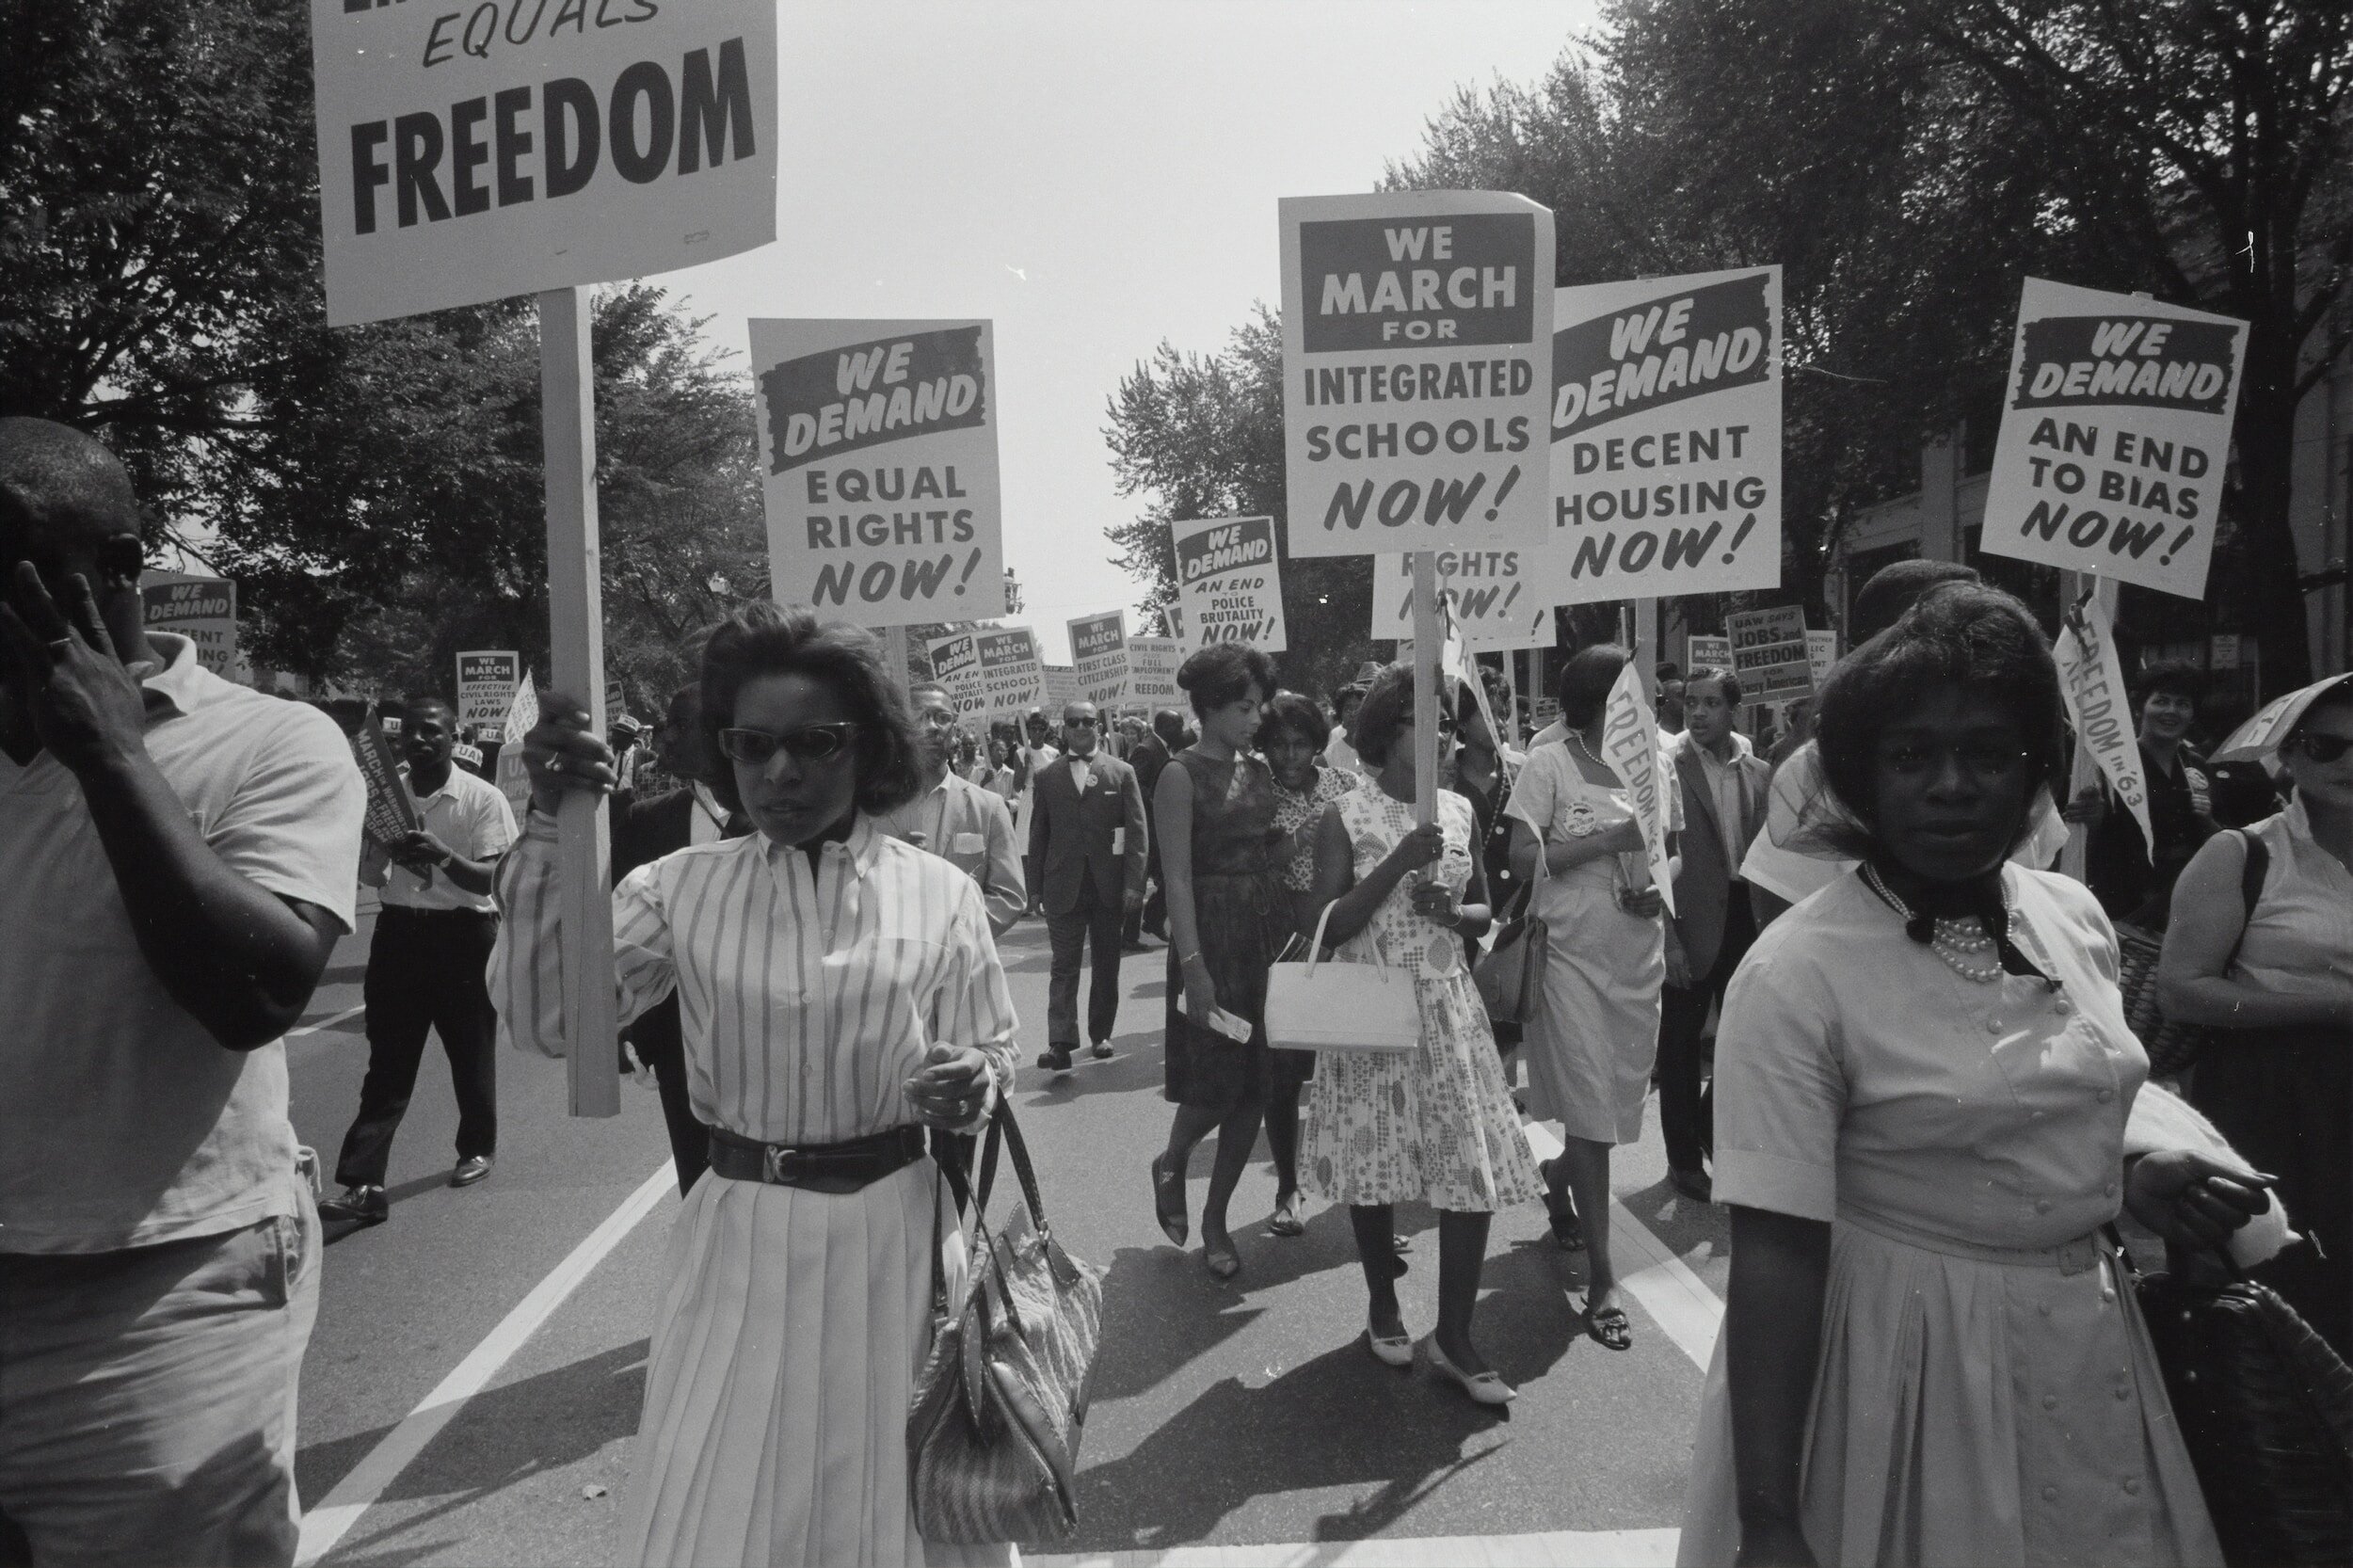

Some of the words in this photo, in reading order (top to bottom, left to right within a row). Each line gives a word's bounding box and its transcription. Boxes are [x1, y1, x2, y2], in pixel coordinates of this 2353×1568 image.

[351, 36, 755, 234] FREEDOM
[1385, 226, 1452, 262] WE
[1321, 265, 1515, 314] MARCH
[1383, 319, 1458, 341] FOR
[1609, 297, 1693, 361] WE
[2091, 321, 2171, 358] WE
[837, 343, 913, 395] WE
[1553, 327, 1762, 429] DEMAND
[2029, 360, 2224, 400] DEMAND
[1305, 359, 1532, 406] INTEGRATED
[784, 375, 977, 456] DEMAND
[1306, 416, 1529, 461] SCHOOLS
[1573, 424, 1749, 475] DECENT
[2028, 417, 2098, 456] AN
[2114, 430, 2209, 479] END
[807, 466, 967, 504] EQUAL
[1324, 464, 1521, 531] NOW!
[2028, 456, 2086, 494] TO
[2099, 470, 2199, 520] BIAS
[1556, 476, 1767, 527] HOUSING
[807, 509, 974, 549] RIGHTS
[1209, 525, 1241, 550] WE
[2021, 500, 2194, 567] NOW!
[1187, 538, 1268, 579] DEMAND
[1571, 513, 1756, 580] NOW!
[812, 547, 982, 606] NOW!
[1401, 552, 1518, 577] RGHTS
[171, 584, 203, 600] WE
[1195, 580, 1223, 594] AN
[1228, 578, 1265, 591] END
[150, 598, 228, 620] DEMAND
[1200, 608, 1263, 624] BRUTALITY
[1211, 596, 1255, 610] POLICE
[1090, 622, 1104, 632] WE
[1201, 616, 1275, 646] NOW!
[1735, 616, 1764, 628] UAW
[1767, 611, 1795, 623] SAYS
[950, 638, 969, 656] WE
[984, 642, 1029, 659] MARCH
[996, 635, 1012, 646] WE
[1078, 630, 1118, 649] MARCH
[1129, 644, 1147, 652] CIVIL
[1150, 644, 1176, 653] RIGHTS
[1735, 627, 1781, 648] JOBS
[1783, 627, 1801, 641] and
[938, 648, 975, 676] DEMA
[1078, 661, 1100, 674] FIRST
[1102, 653, 1127, 666] CLASS
[1736, 645, 1806, 667] FREEDOM
[465, 665, 510, 676] MARCH
[945, 673, 960, 683] AN
[965, 670, 979, 680] EN
[983, 662, 1037, 680] INTEGRATED
[1078, 664, 1129, 686] CITIZENSHIP
[1767, 676, 1808, 690] American
[955, 680, 982, 693] POLICE
[986, 675, 1040, 693] SCHOOLS
[1088, 679, 1128, 704] NOW!
[2082, 620, 2125, 754] FREEDOM
[994, 686, 1039, 709] NOW!
[466, 706, 512, 718] NOW!
[356, 728, 385, 778] MARCH
[1605, 690, 1656, 819] FREEDOM
[376, 803, 404, 839] FREEDO
